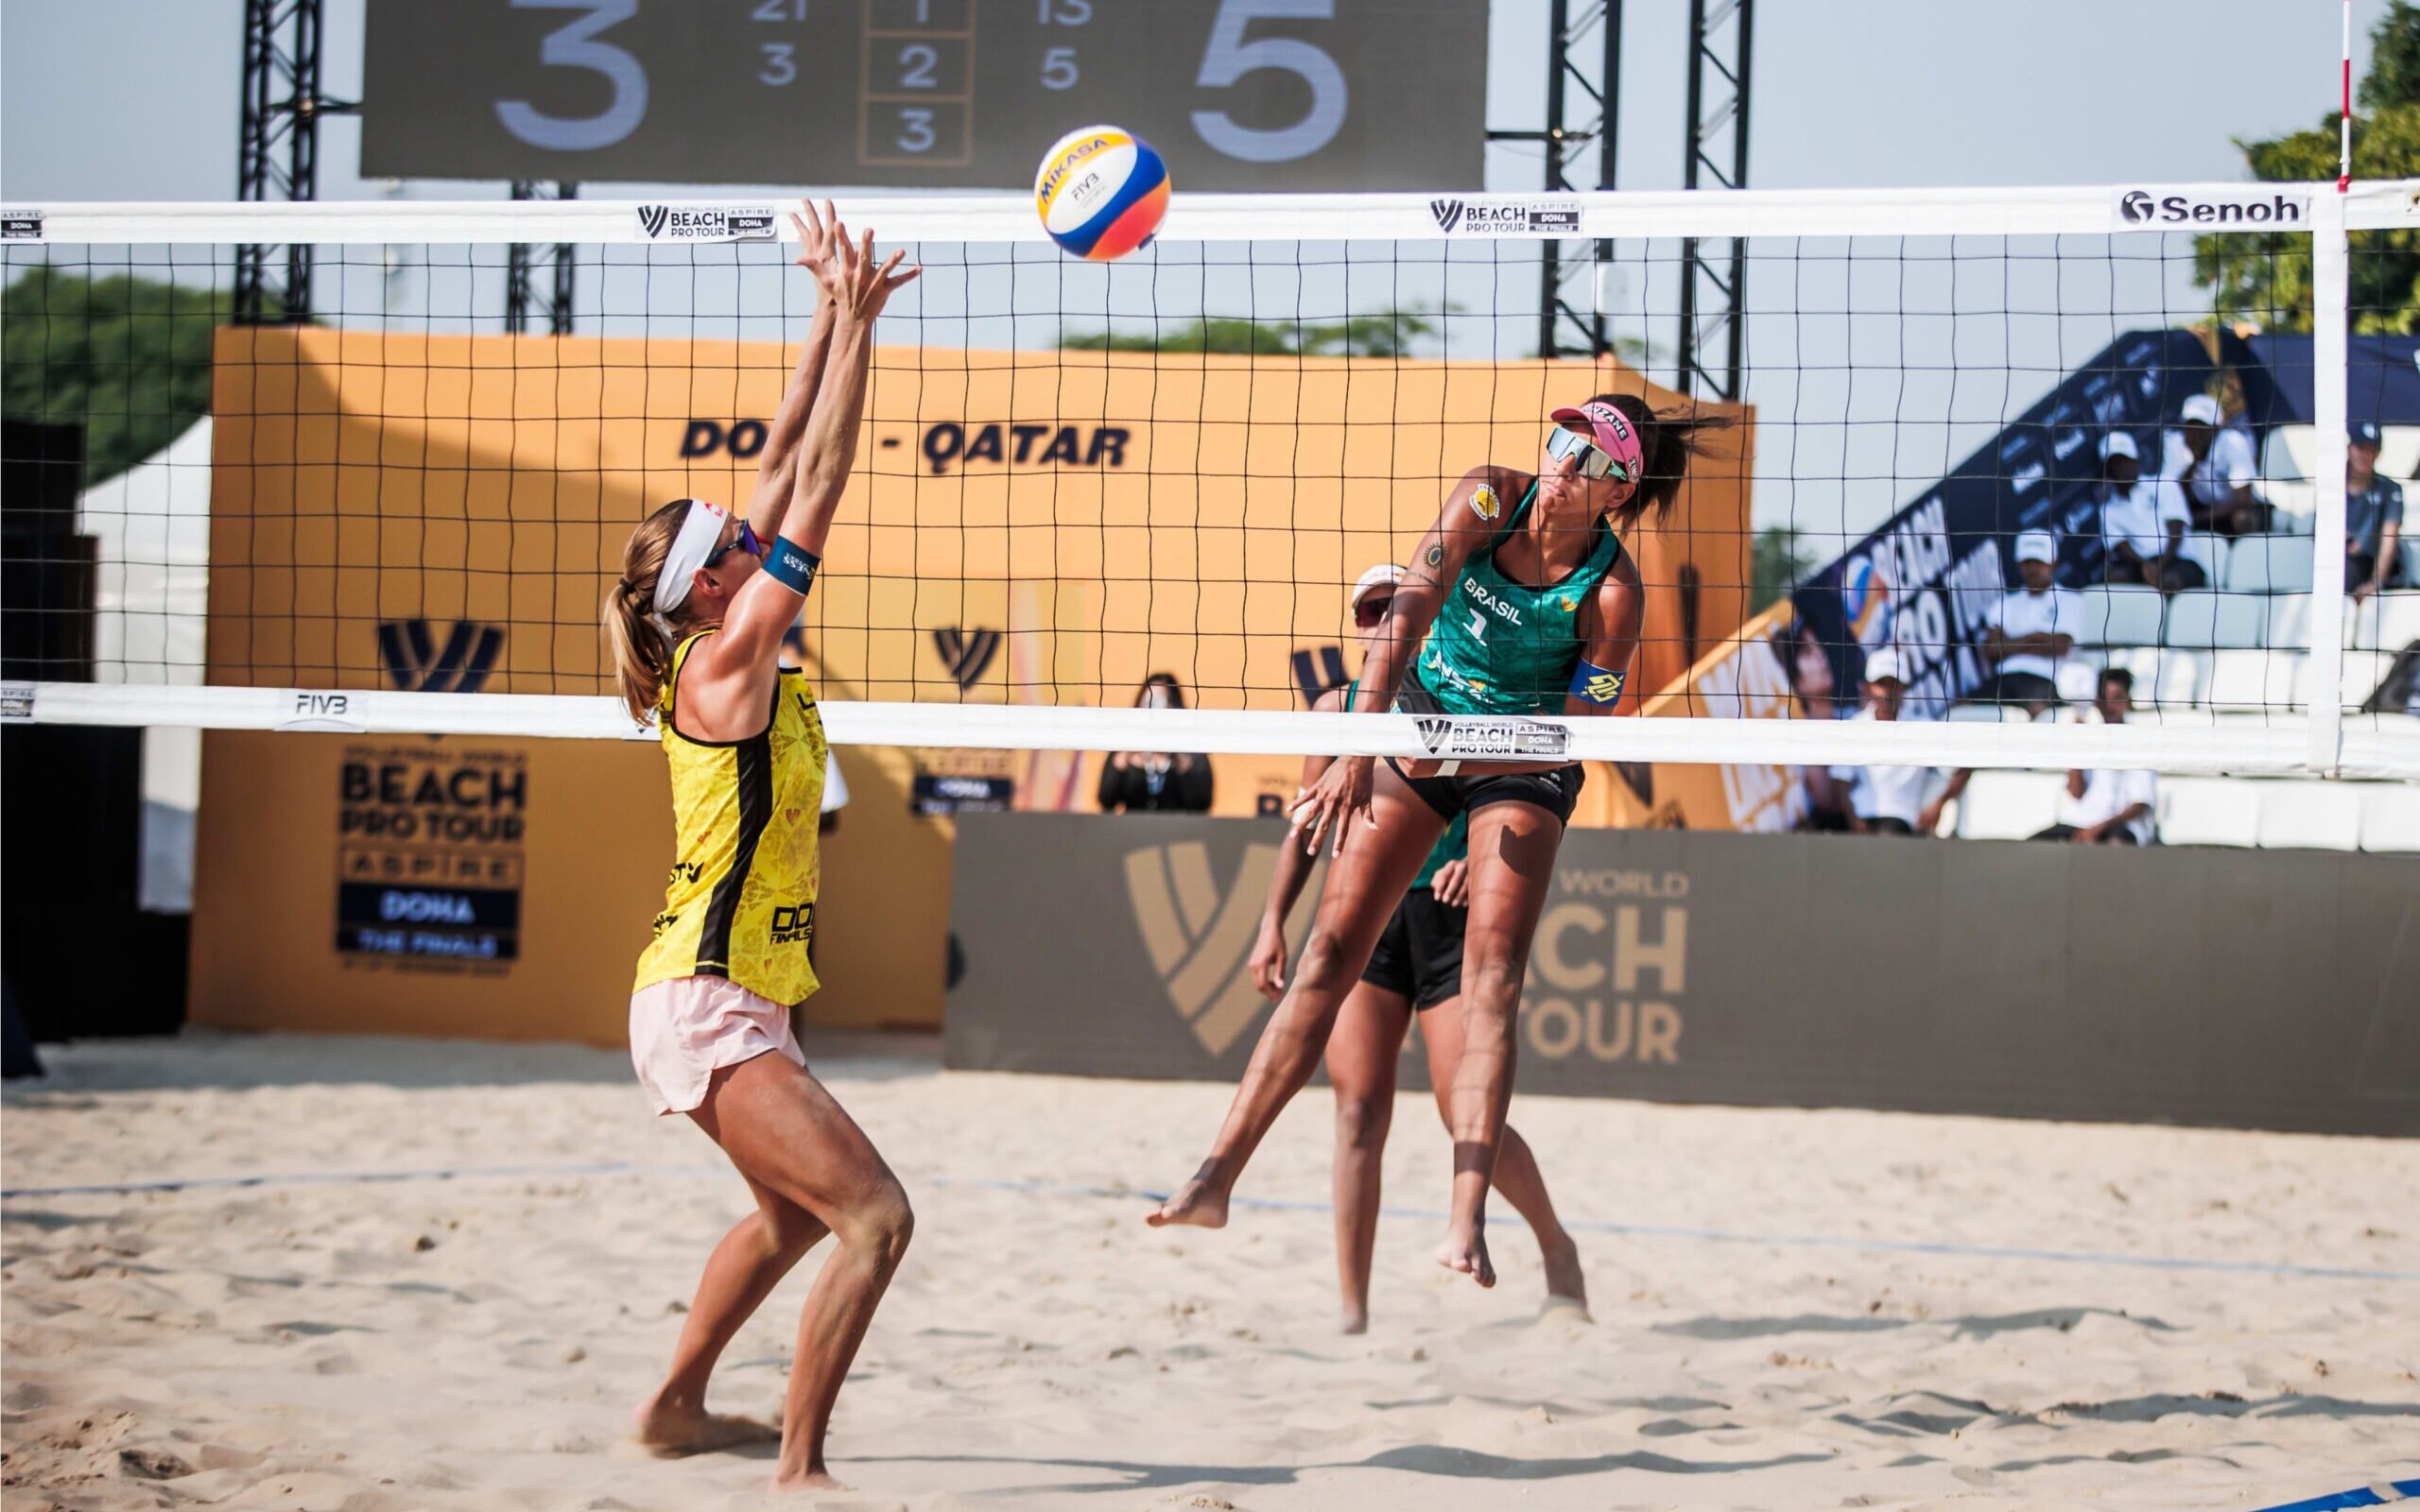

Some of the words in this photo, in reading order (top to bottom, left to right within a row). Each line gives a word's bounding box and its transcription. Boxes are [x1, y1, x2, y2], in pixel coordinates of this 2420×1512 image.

[495, 0, 650, 151] 3
[758, 43, 797, 86] 3
[900, 45, 937, 88] 2
[1041, 48, 1080, 90] 5
[1189, 0, 1348, 163] 5
[898, 109, 936, 152] 3
[671, 213, 724, 226] BEACH
[1466, 208, 1525, 220] BEACH
[1541, 214, 1566, 222] DOHA
[2162, 196, 2299, 222] Senoh
[671, 228, 693, 236] PRO
[696, 228, 724, 236] TOUR
[1466, 223, 1491, 232] PRO
[1495, 223, 1525, 232] TOUR
[679, 420, 767, 459] DO
[923, 421, 1131, 474] QATAR
[1464, 576, 1523, 627] BRASIL
[1462, 607, 1488, 647] 1
[1453, 728, 1512, 743] BEACH
[1519, 725, 1564, 733] ASPIRE
[1528, 736, 1554, 745] DOHA
[1452, 744, 1476, 753] PRO
[1479, 744, 1512, 753] TOUR
[340, 764, 527, 810] BEACH
[340, 809, 419, 838] PRO
[427, 813, 524, 842] TOUR
[353, 855, 510, 880] ASPIRE
[1561, 868, 1690, 897] WORLD
[380, 890, 475, 923] DOHA
[771, 902, 816, 932] DO
